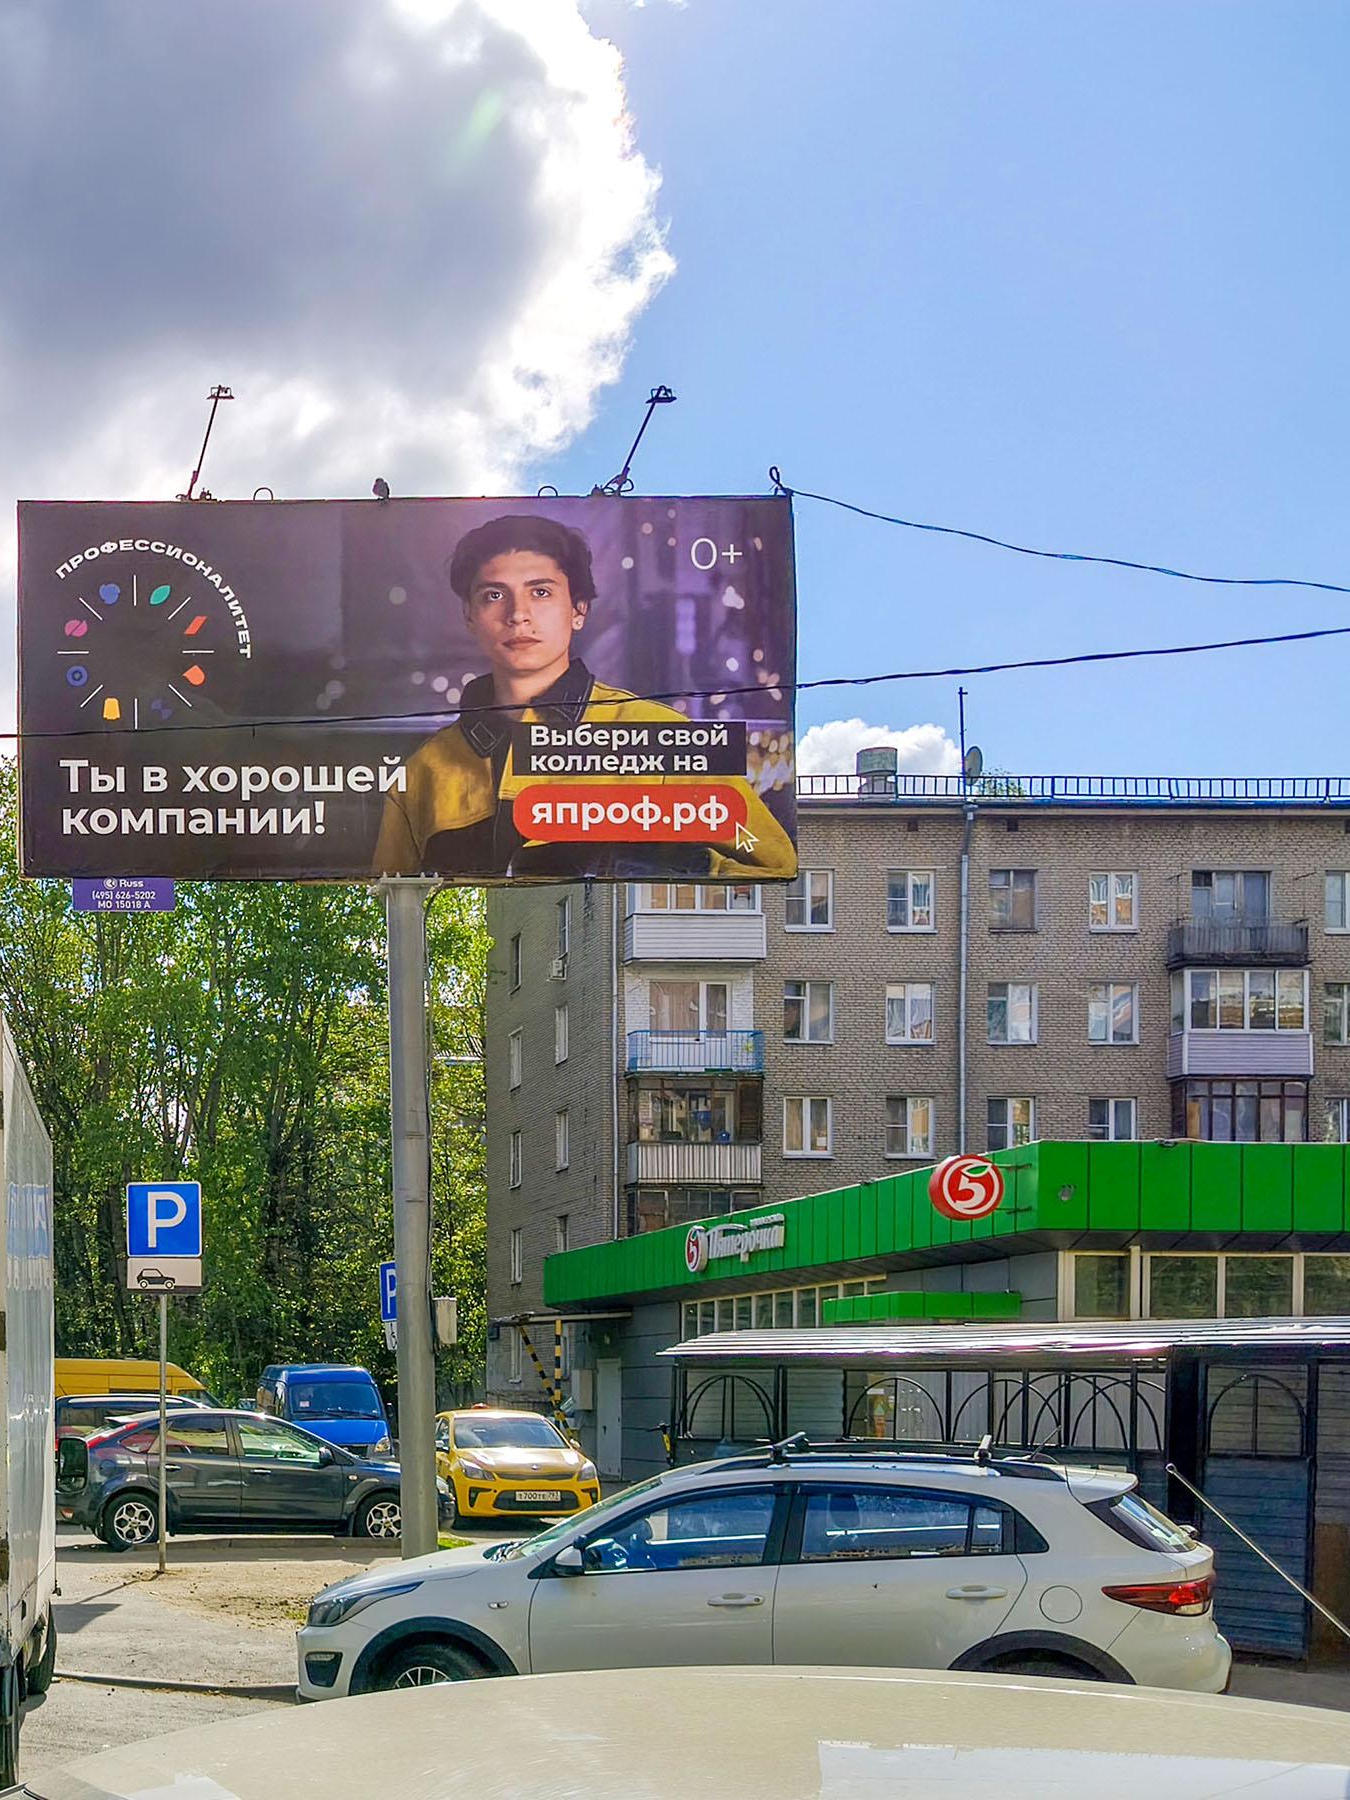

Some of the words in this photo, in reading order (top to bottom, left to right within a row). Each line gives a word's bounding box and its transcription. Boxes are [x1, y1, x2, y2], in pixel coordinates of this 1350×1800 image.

[691, 538, 743, 570] 0+
[55, 539, 251, 659] ПРОФЕССИОНАЛИТЕТ
[530, 725, 649, 751] Выбери
[657, 723, 728, 746] свой
[59, 759, 125, 793] Ты
[142, 766, 168, 793] в
[182, 756, 408, 801] хорошей
[530, 754, 664, 775] колледж
[673, 755, 708, 772] на
[62, 801, 326, 835] компании!
[531, 795, 729, 832] япроф.рф
[92, 890, 113, 900] (495)
[115, 891, 156, 900] 626-5202
[119, 879, 144, 888] Russ
[148, 1191, 187, 1248] P
